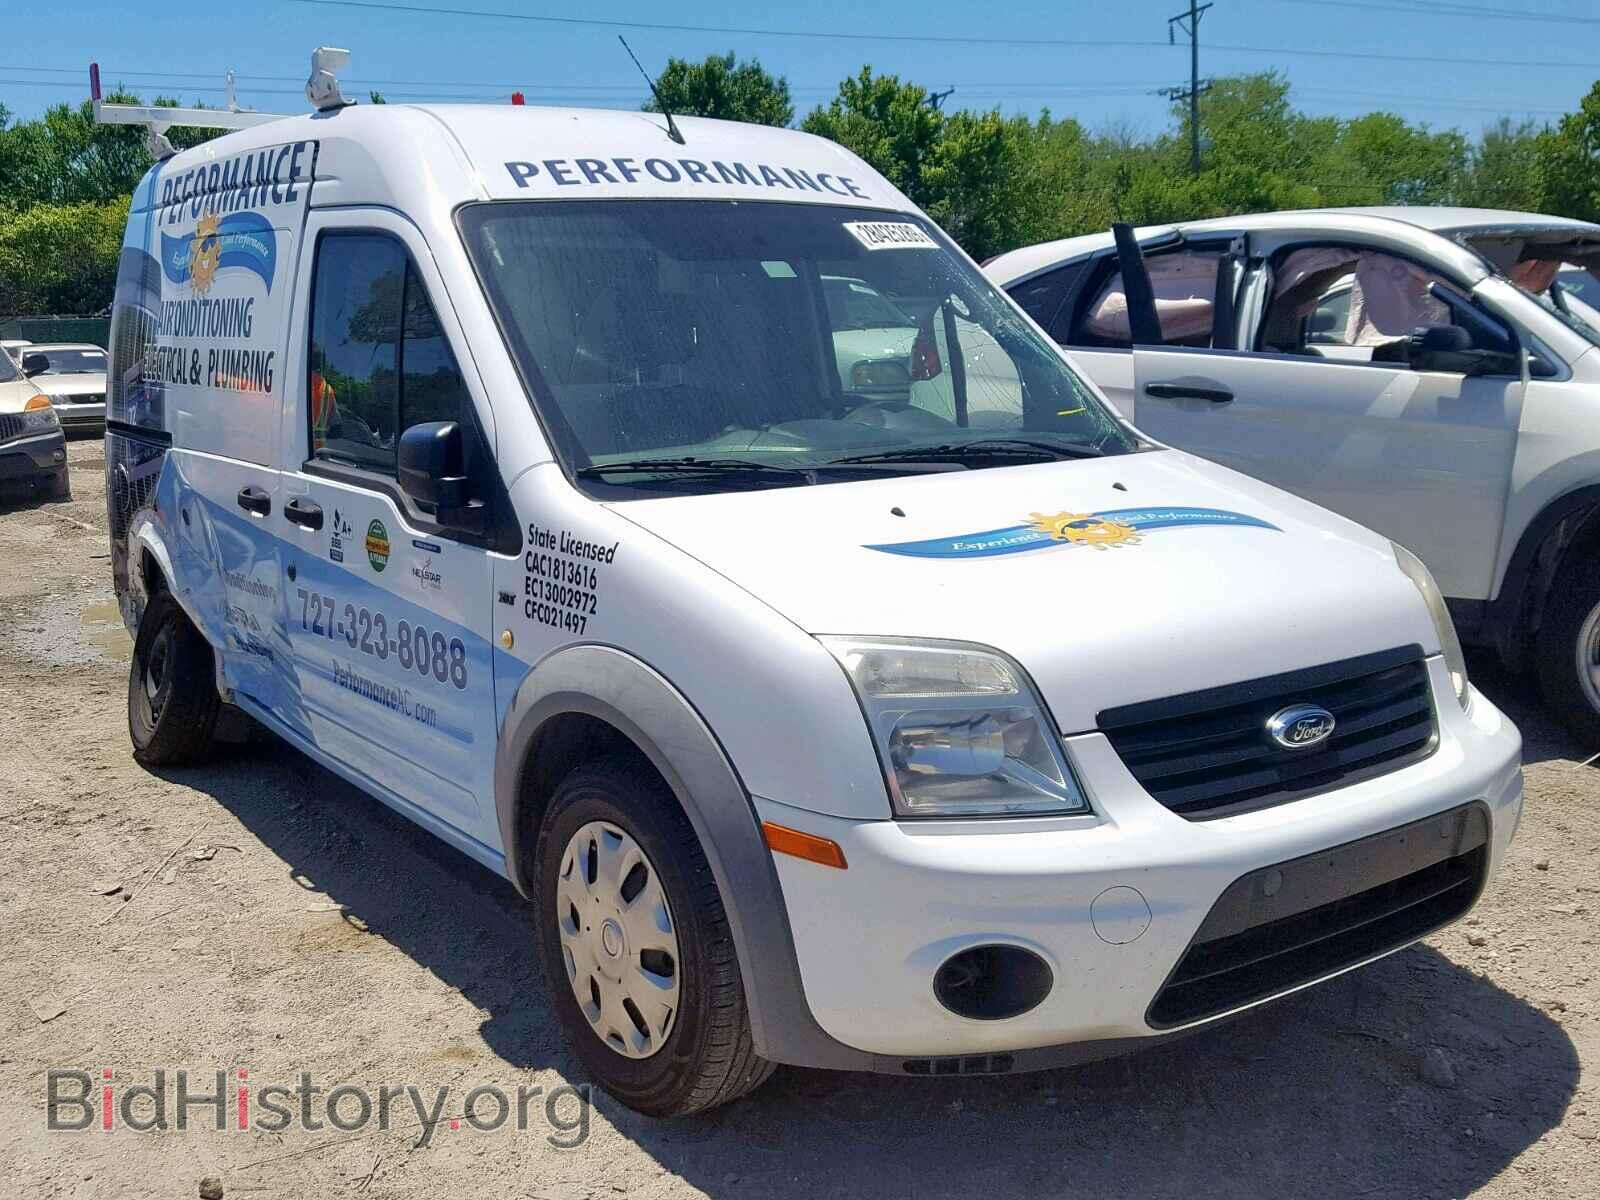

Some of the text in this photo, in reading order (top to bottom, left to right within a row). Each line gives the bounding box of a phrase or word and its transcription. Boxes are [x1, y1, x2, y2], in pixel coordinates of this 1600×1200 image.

[504, 157, 872, 200] PERFORMANCE
[190, 347, 203, 386] &
[207, 348, 275, 393] PLUMBING
[528, 523, 620, 564] State Licensed
[525, 550, 597, 590] CAC1813616
[525, 576, 598, 615] EC13002972
[524, 600, 587, 635] CFC021497
[297, 588, 469, 690] 727-323-8088
[1293, 718, 1325, 741] Ford
